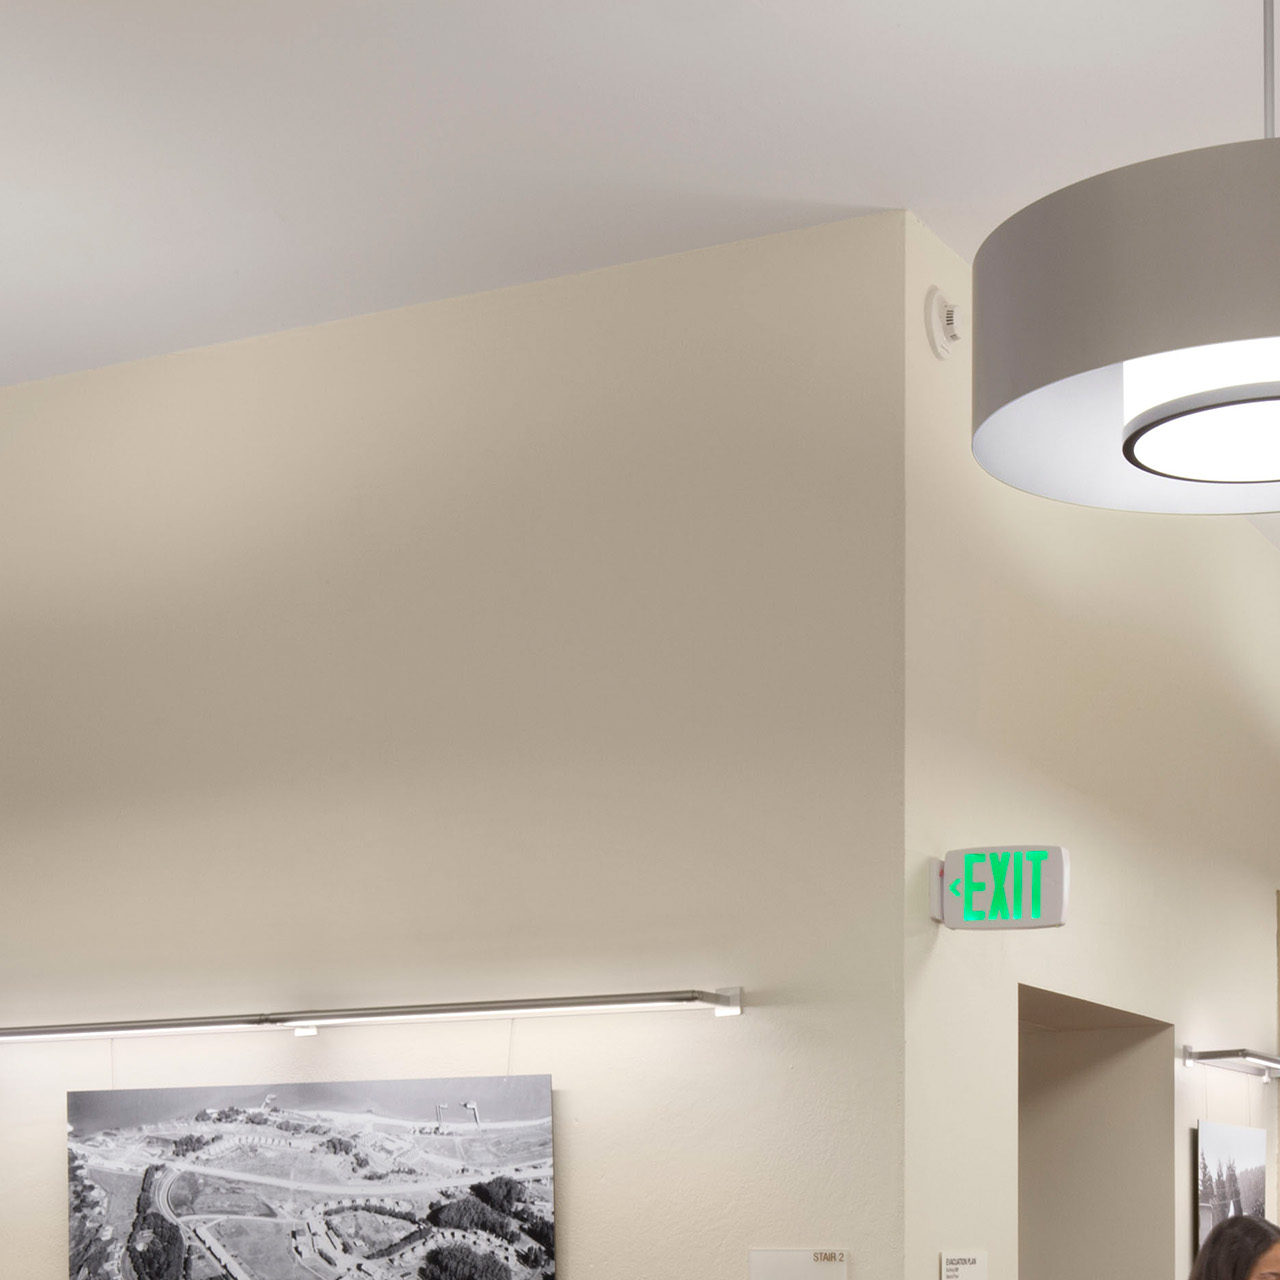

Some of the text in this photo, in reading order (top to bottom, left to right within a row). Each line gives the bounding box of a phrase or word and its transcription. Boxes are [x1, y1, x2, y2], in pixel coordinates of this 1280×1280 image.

[963, 850, 1048, 921] EXIT
[813, 1252, 844, 1262] STAIR 2
